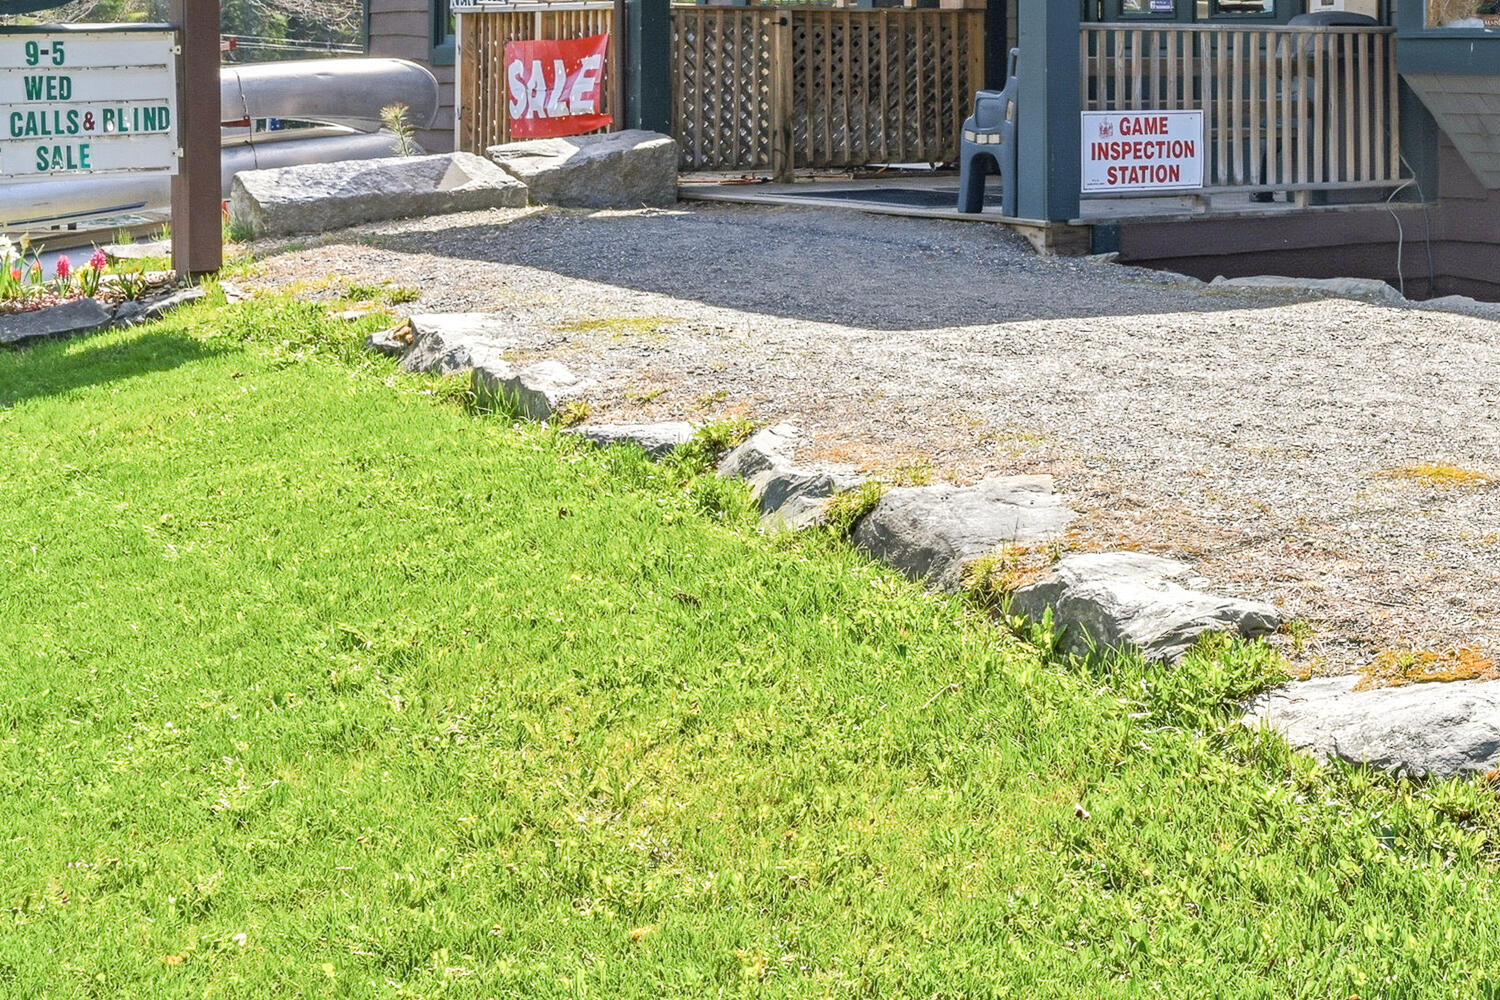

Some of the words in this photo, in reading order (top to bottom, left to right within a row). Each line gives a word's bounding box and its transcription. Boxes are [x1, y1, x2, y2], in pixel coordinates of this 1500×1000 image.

[25, 41, 65, 66] 9-5
[24, 75, 72, 101] WED
[508, 54, 601, 120] SALE
[10, 109, 79, 137] CALLS
[83, 111, 95, 131] &
[102, 106, 170, 133] BLIND
[1119, 116, 1168, 136] GAME
[36, 143, 91, 171] SALE
[1091, 140, 1195, 160] INSPECTION
[1107, 164, 1180, 185] STATION
